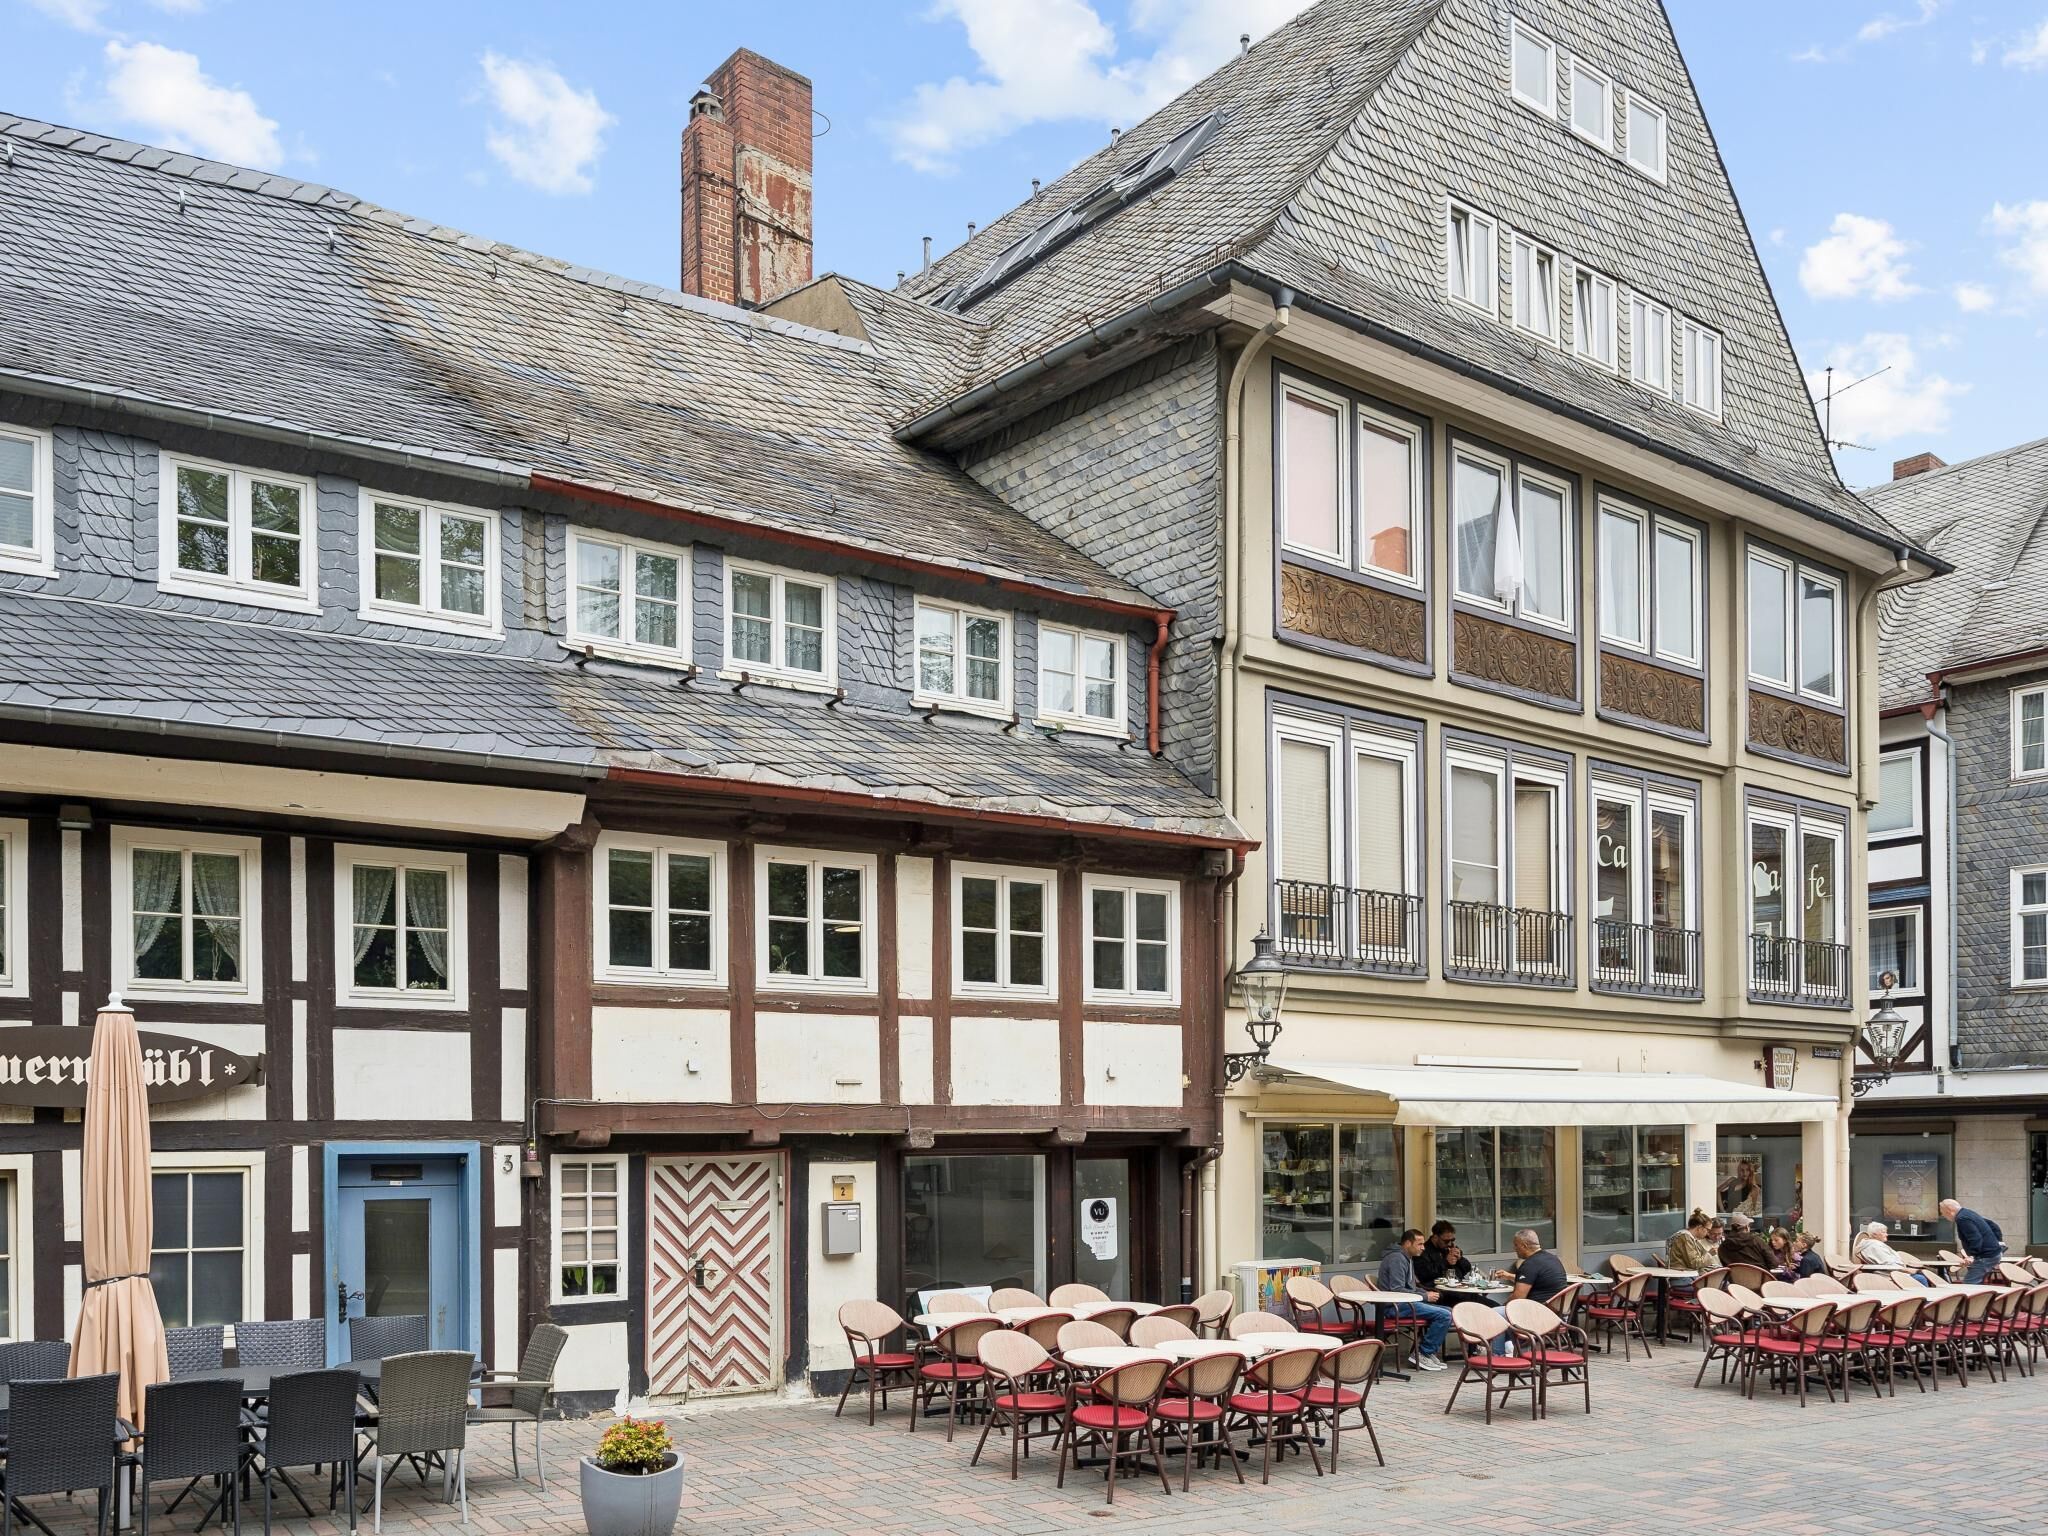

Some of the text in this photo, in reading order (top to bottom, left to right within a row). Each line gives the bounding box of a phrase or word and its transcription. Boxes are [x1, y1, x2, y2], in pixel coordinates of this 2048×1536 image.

[1597, 834, 1628, 869] Ca
[1806, 863, 1827, 910] fe
[1775, 1076, 1790, 1088] HAUS
[502, 1154, 514, 1172] 3
[840, 1186, 846, 1197] 2
[1093, 1207, 1105, 1216] VU
